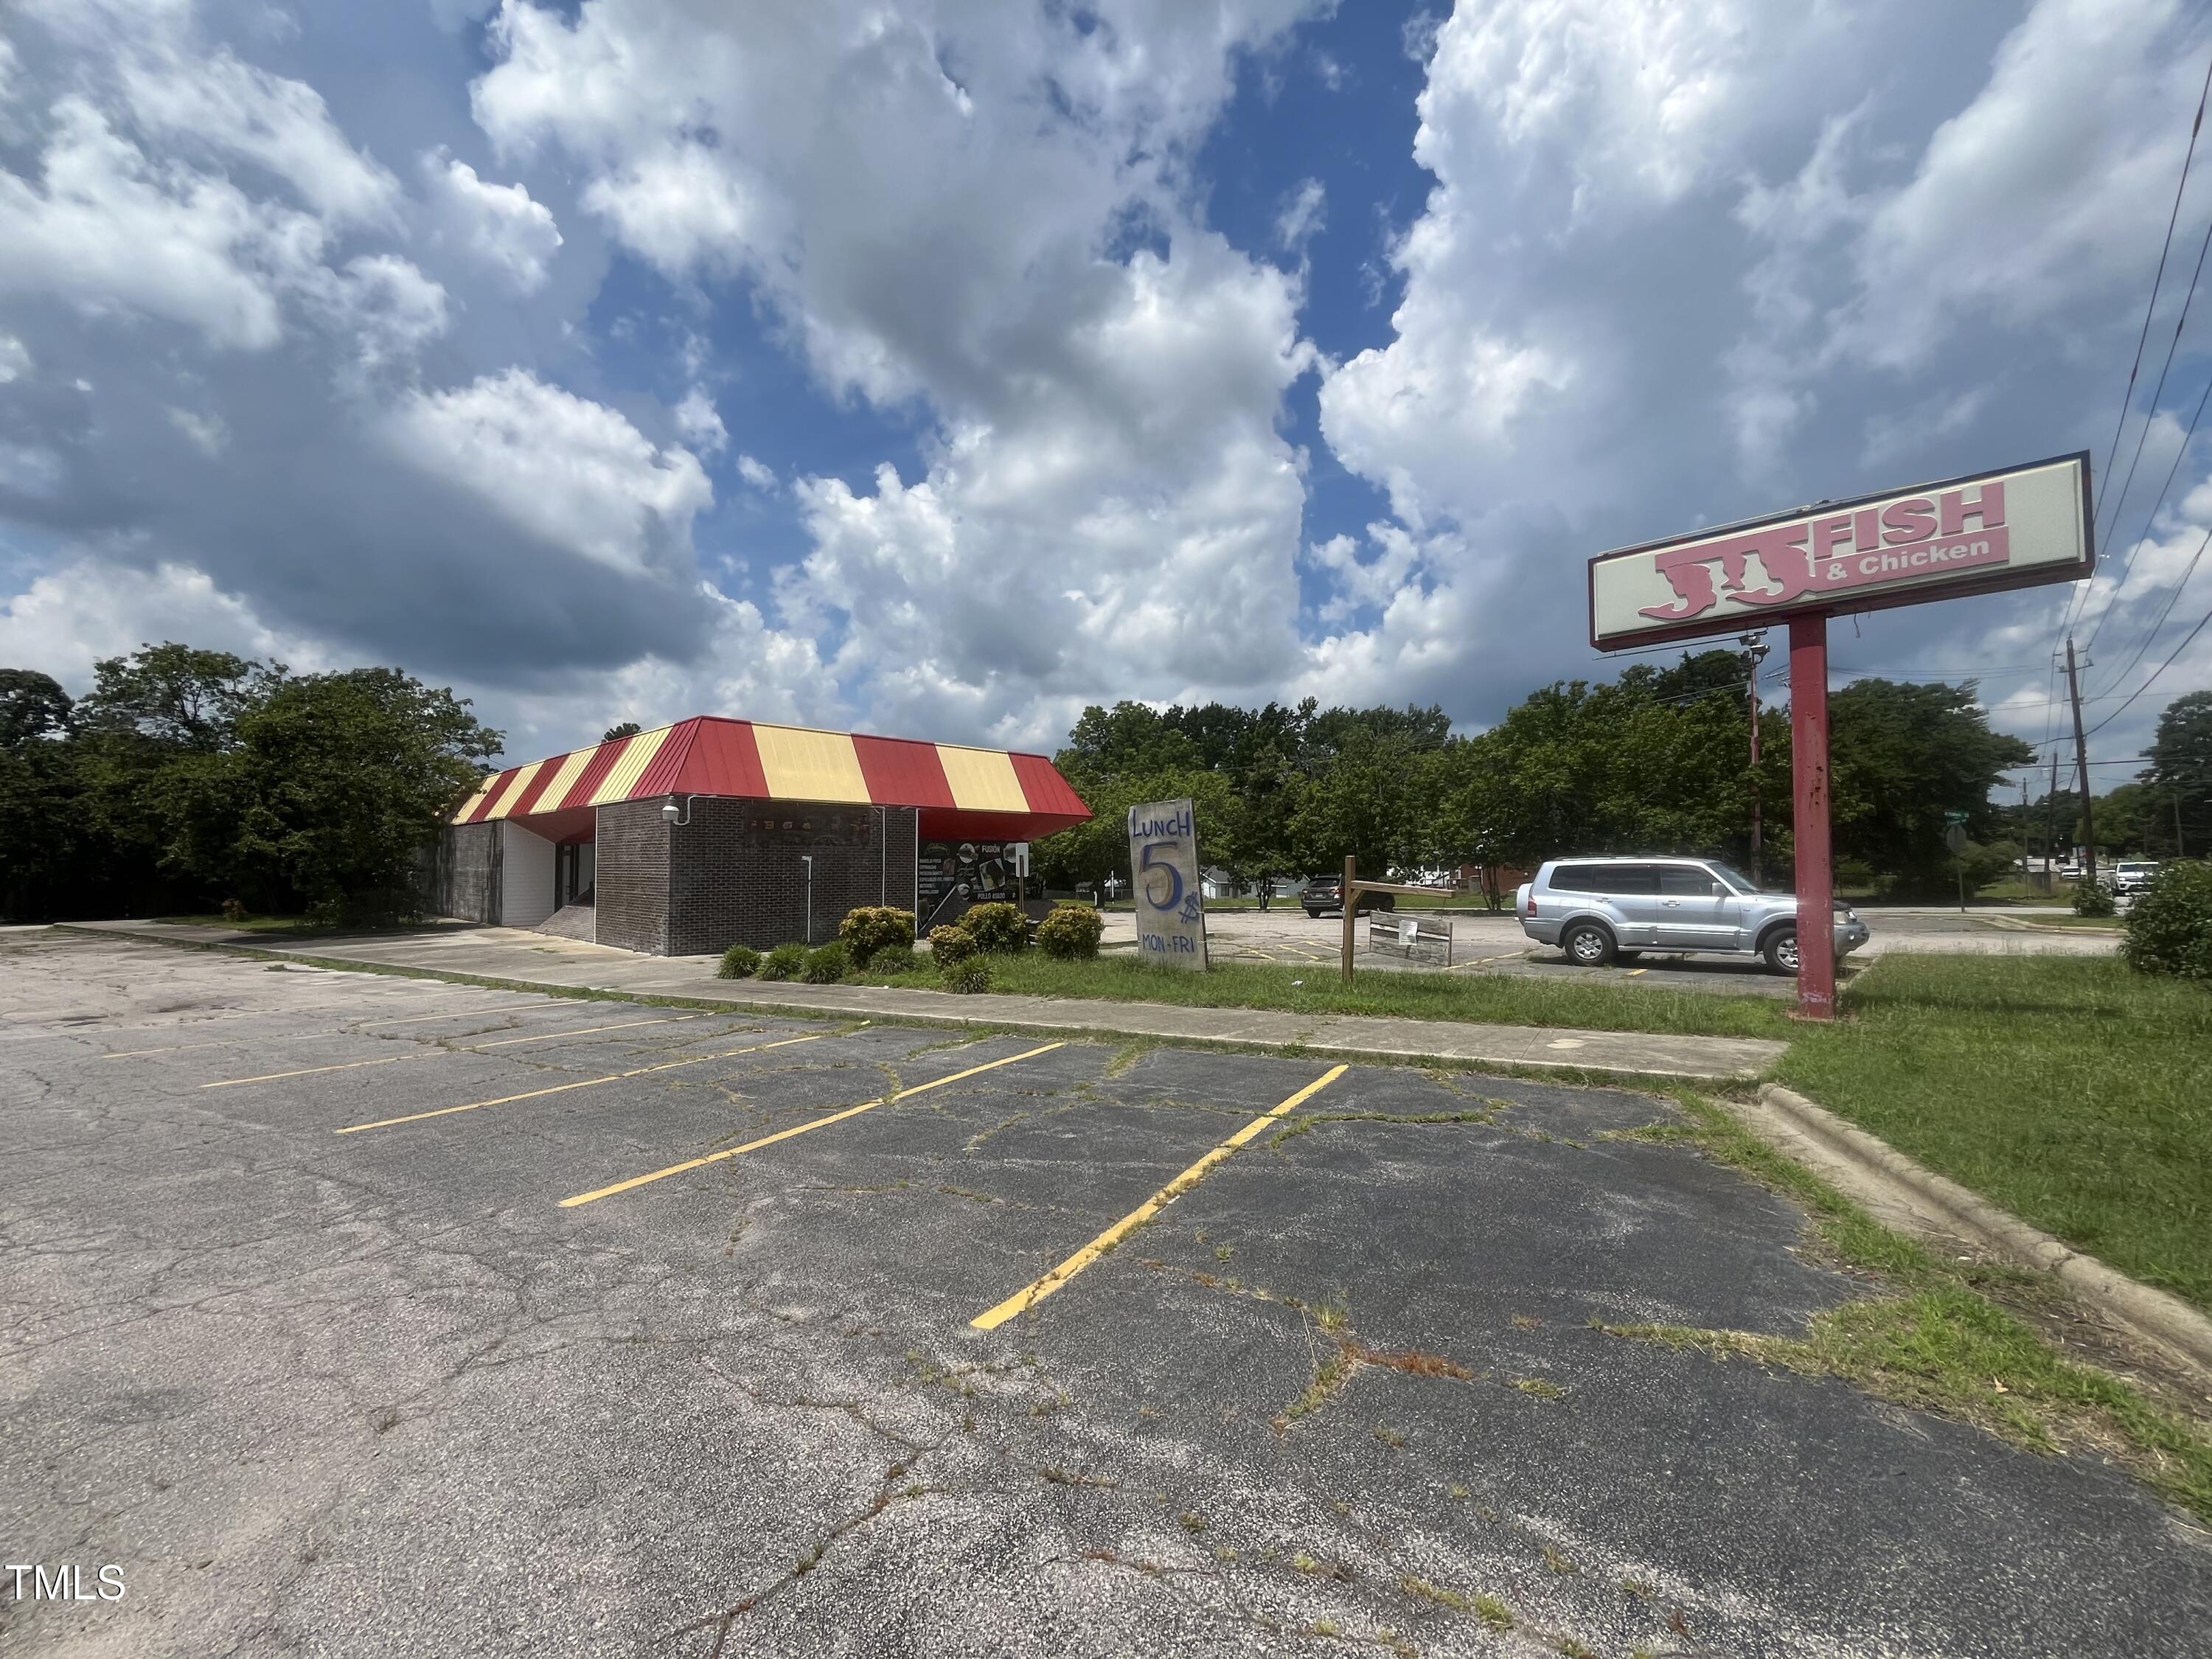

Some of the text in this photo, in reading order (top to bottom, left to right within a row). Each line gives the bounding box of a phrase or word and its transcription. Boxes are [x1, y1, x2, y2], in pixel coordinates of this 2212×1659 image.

[1812, 481, 2006, 561] FISH
[1826, 539, 1990, 581] & Chicken
[1132, 809, 1191, 838] LUNCH
